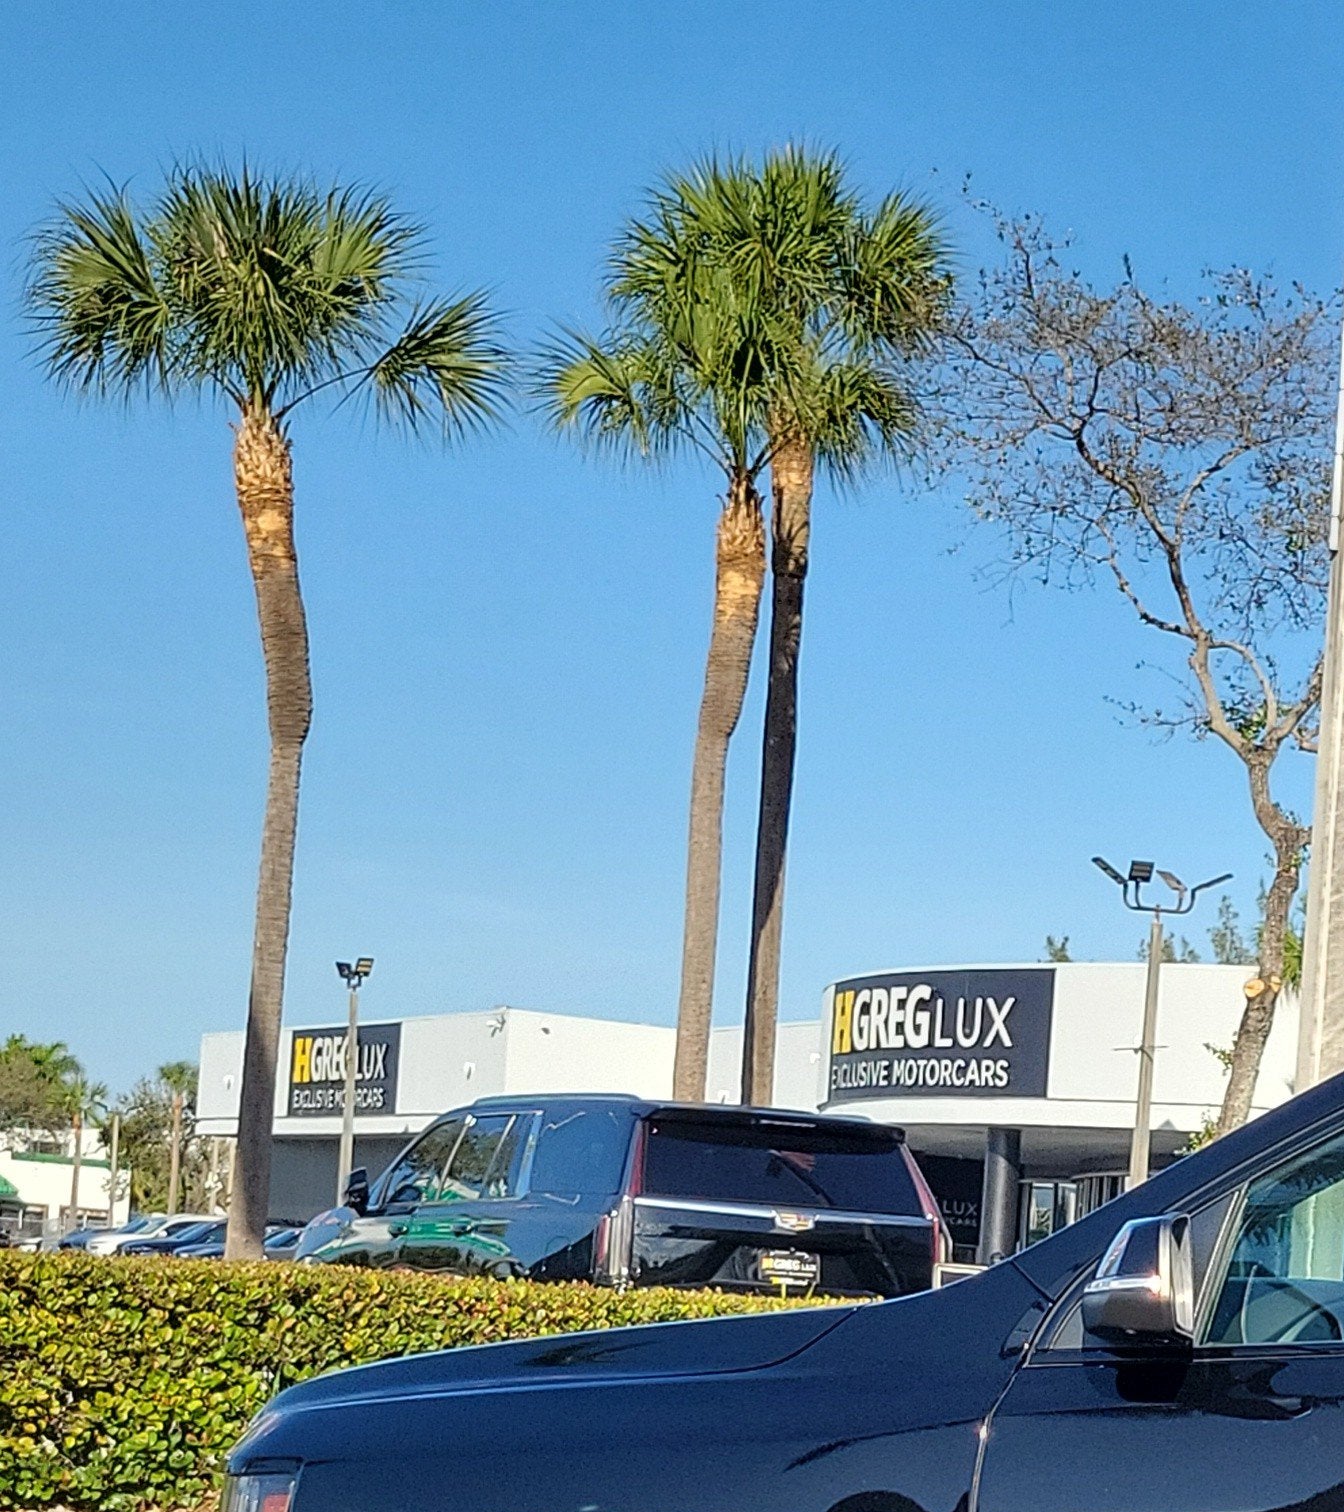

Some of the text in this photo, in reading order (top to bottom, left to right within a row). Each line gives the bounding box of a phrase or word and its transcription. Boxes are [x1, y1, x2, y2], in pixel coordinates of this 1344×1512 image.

[832, 984, 1016, 1055] HGREG LUX
[831, 1058, 1010, 1090] EXCLUSIVE MOTORCARS
